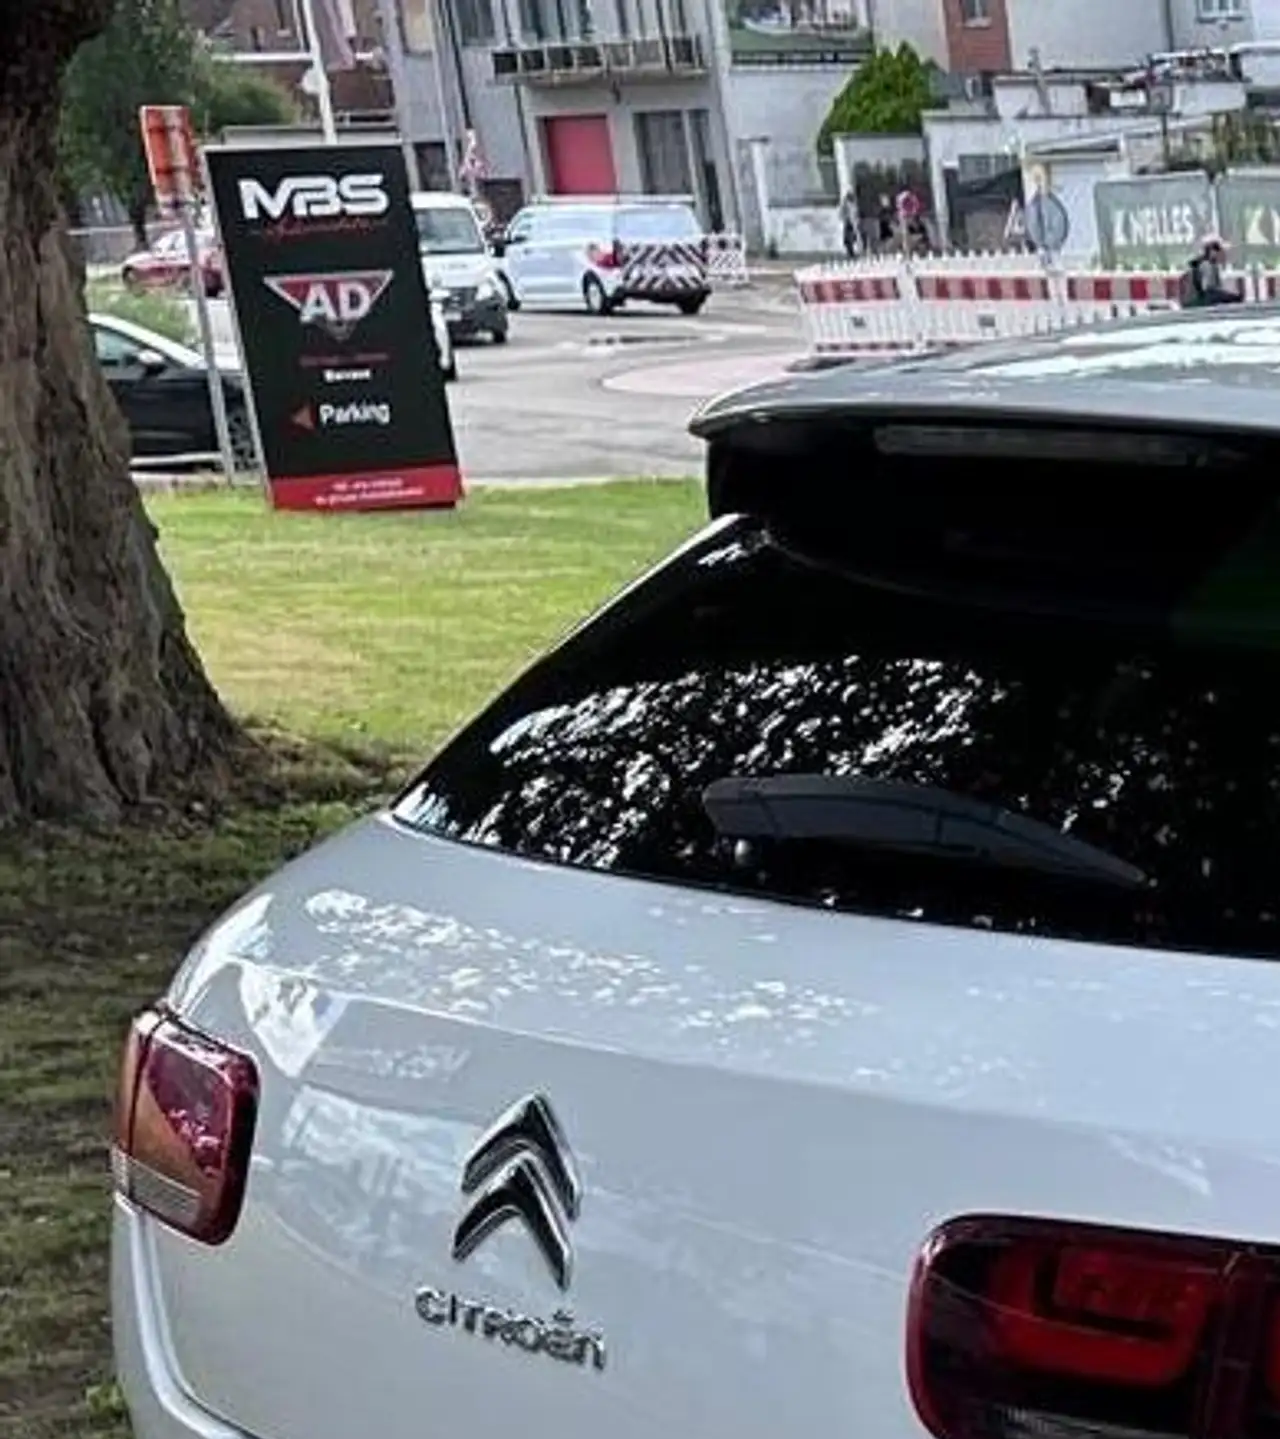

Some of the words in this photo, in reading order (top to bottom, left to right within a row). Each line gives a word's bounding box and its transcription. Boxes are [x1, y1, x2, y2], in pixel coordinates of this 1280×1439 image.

[237, 173, 390, 219] MBS
[1128, 202, 1195, 245] NELLES
[300, 281, 372, 323] AD
[318, 400, 391, 425] Parking
